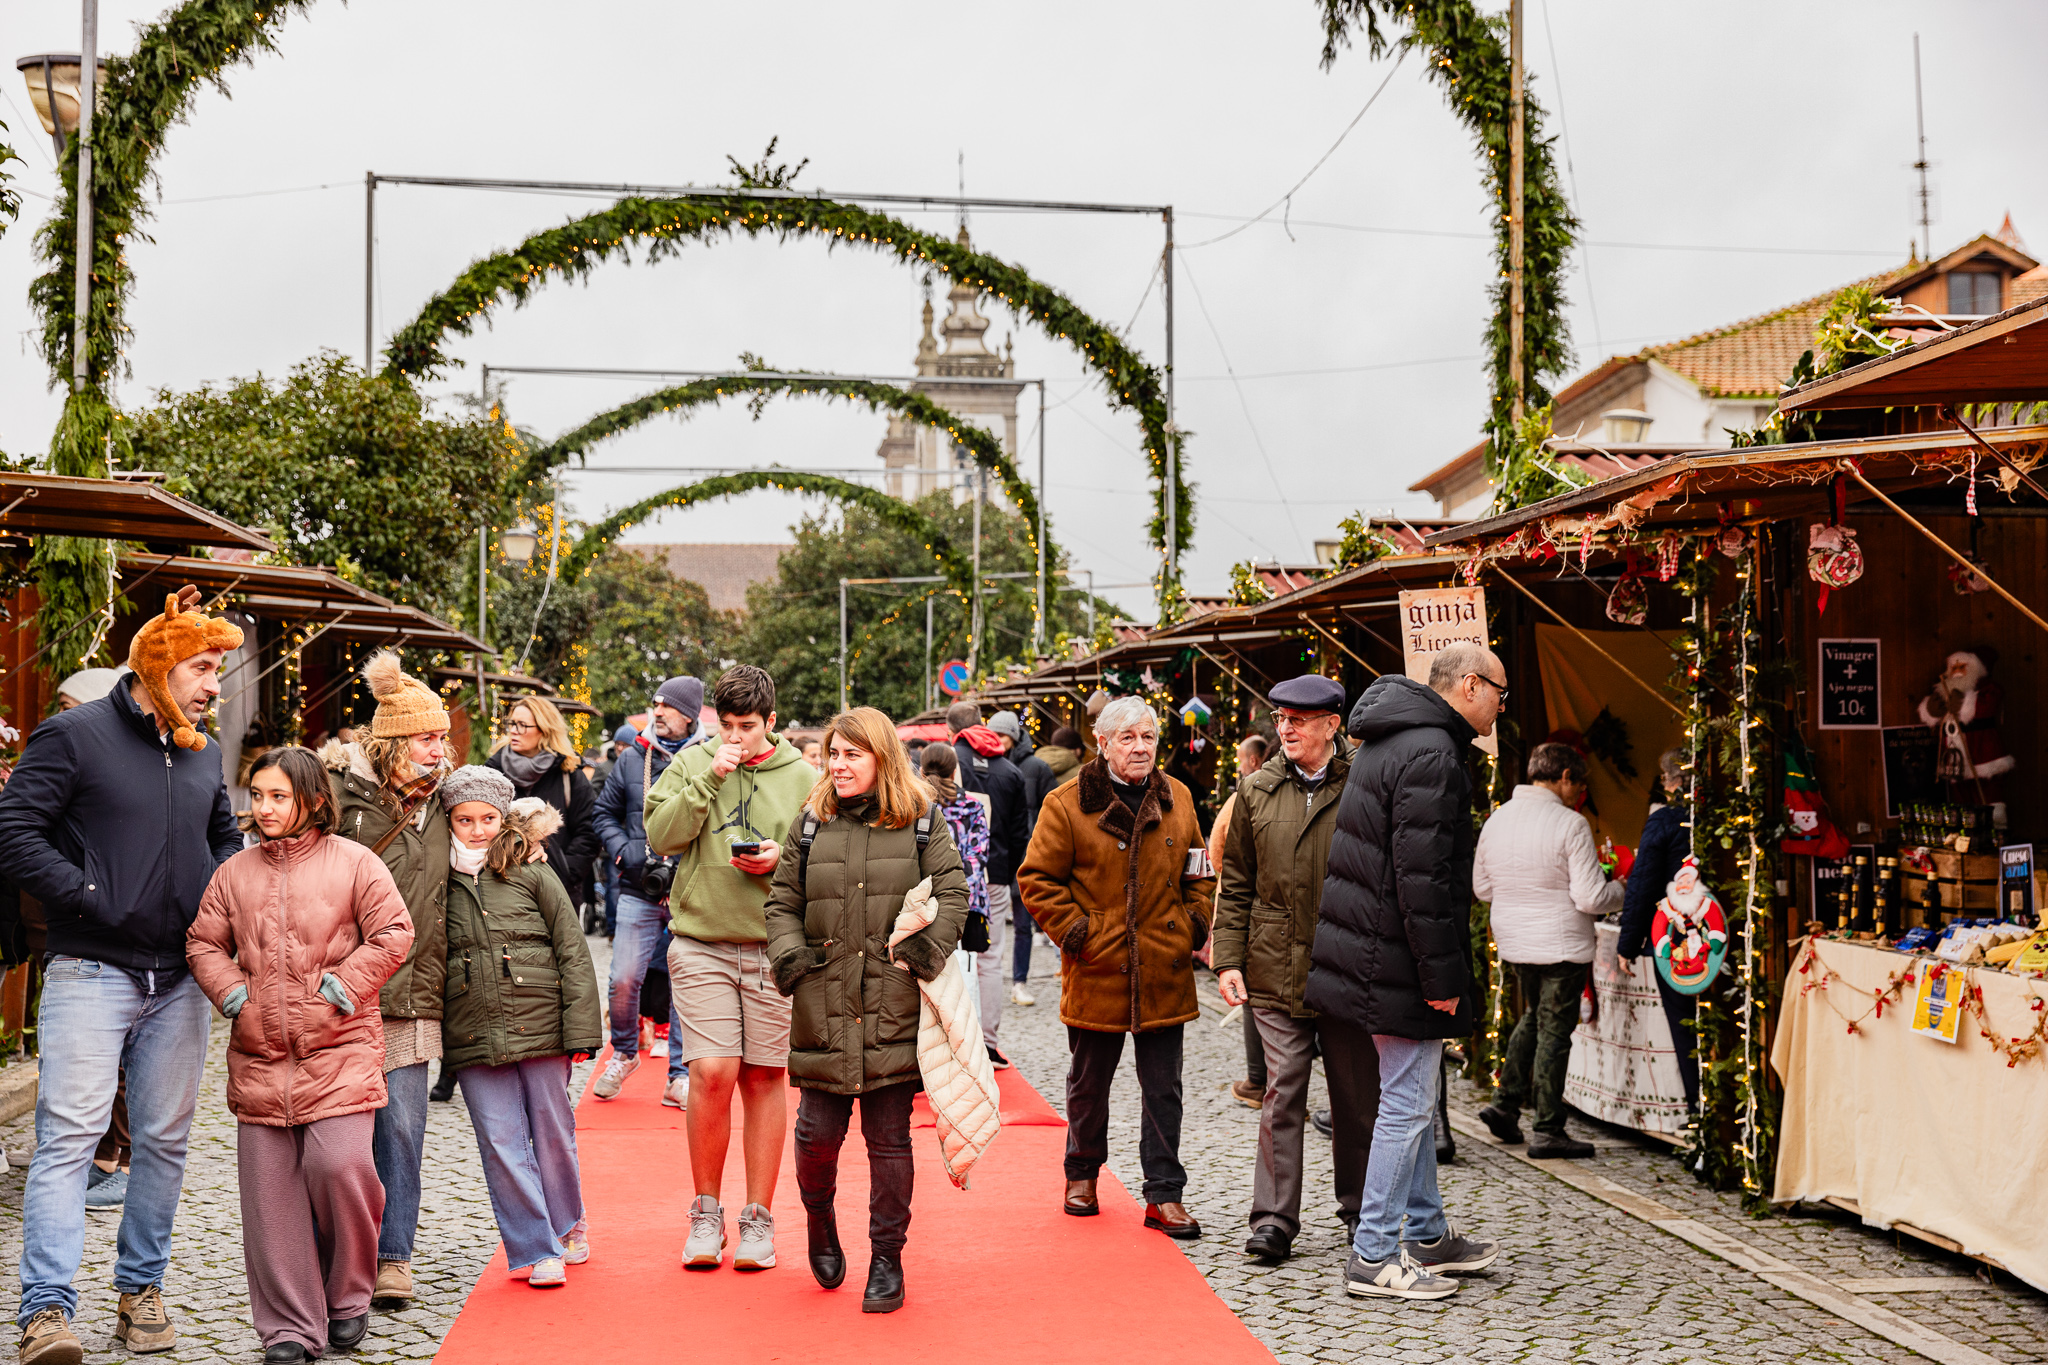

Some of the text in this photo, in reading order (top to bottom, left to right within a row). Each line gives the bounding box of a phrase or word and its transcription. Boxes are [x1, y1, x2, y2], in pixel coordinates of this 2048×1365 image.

[1409, 596, 1478, 630] ginja
[1825, 647, 1875, 664] Vinagre
[1843, 664, 1858, 680] +
[1827, 682, 1874, 694] Ajo negro
[1838, 699, 1867, 716] 10€
[2005, 862, 2029, 878] azul
